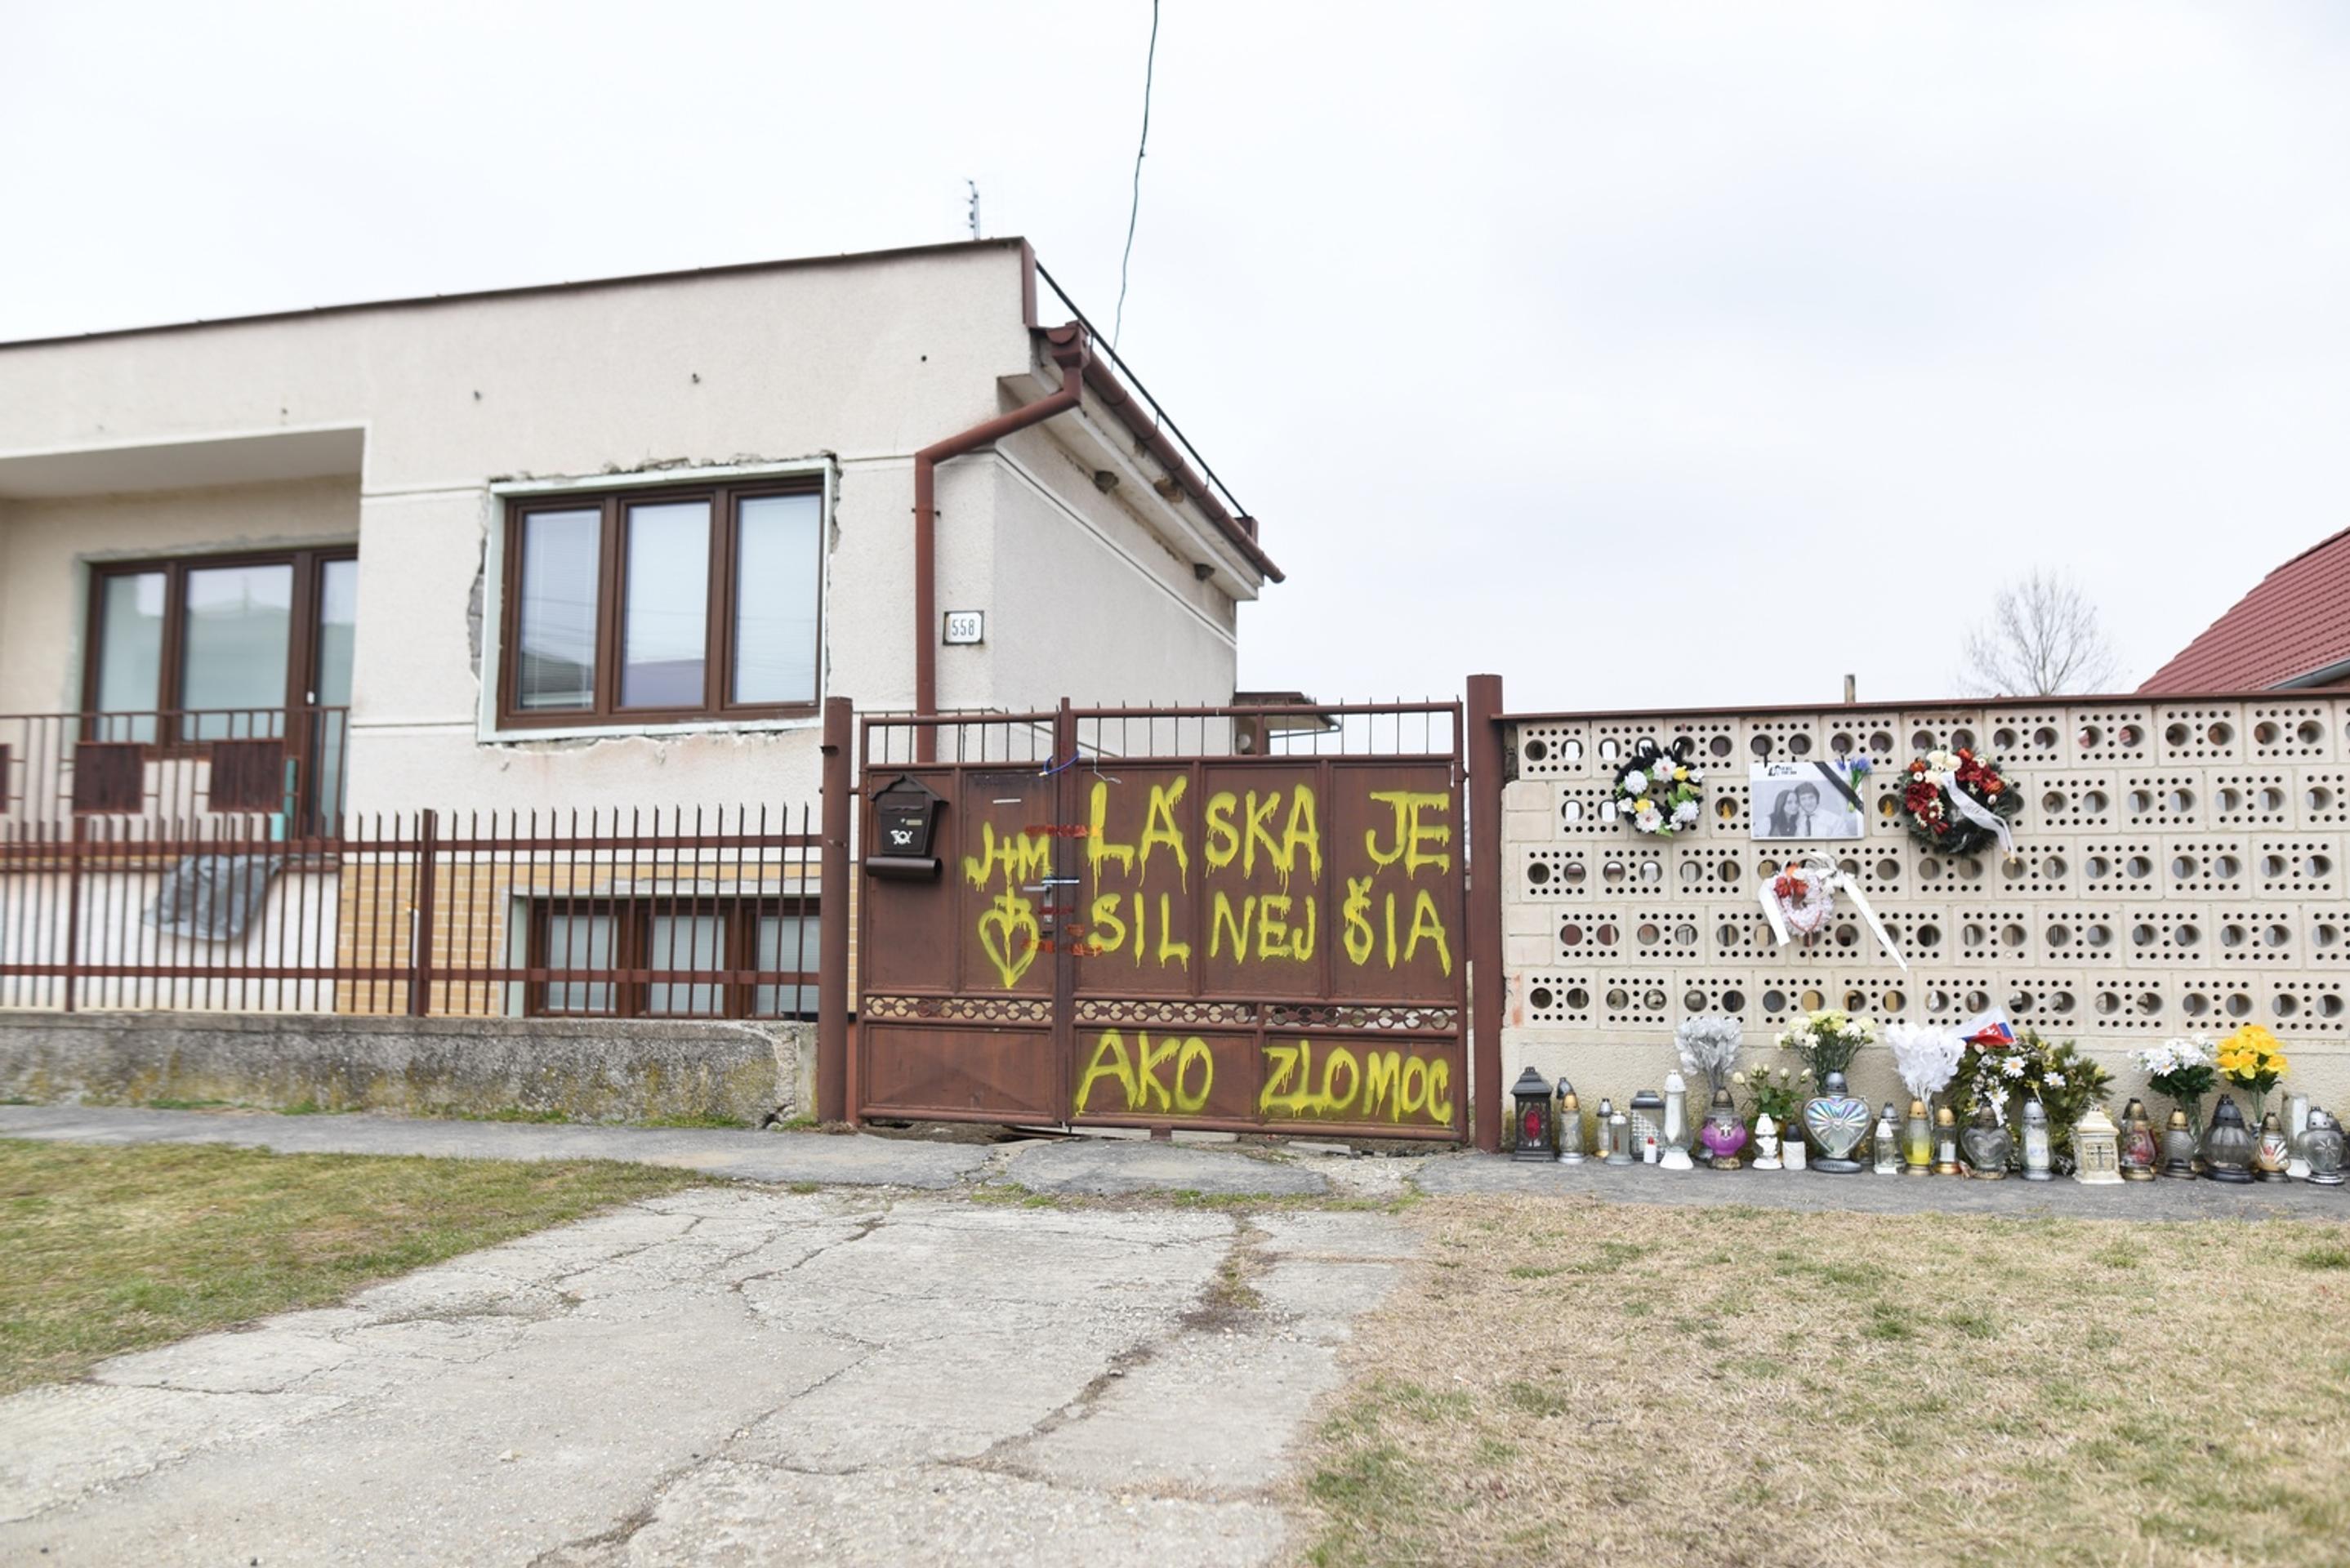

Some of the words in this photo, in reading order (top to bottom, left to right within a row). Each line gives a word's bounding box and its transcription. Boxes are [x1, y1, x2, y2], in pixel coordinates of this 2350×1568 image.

[952, 618, 975, 636] 558
[1088, 776, 1322, 889] LÁSKA
[1366, 791, 1451, 880] JE
[1075, 1028, 1213, 1114] AKO
[1260, 1040, 1452, 1125] ZLOMOC
